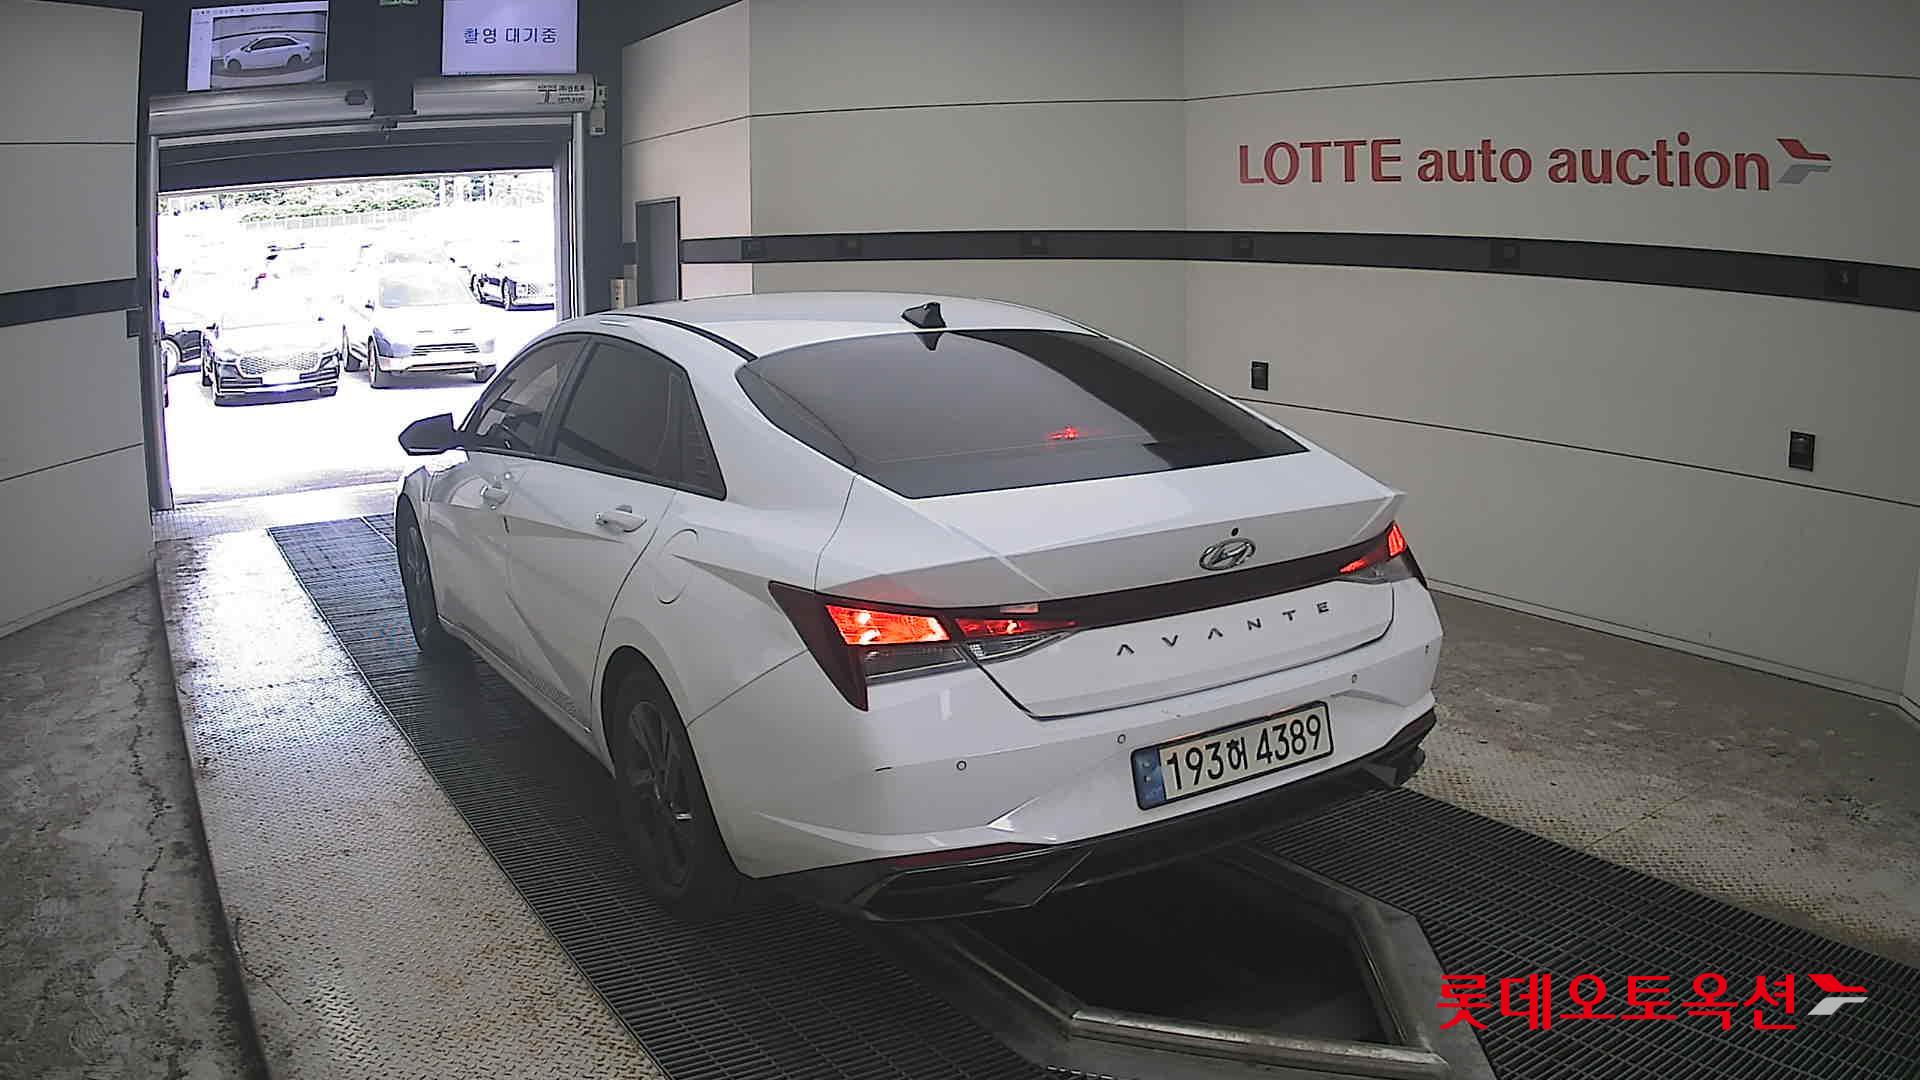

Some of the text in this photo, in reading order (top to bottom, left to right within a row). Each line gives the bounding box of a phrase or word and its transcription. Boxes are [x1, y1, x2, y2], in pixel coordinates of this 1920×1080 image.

[463, 27, 558, 44] 촬영 대기중
[1239, 131, 1770, 191] LOTTE auto auction
[1116, 601, 1330, 656] AVANTE
[1166, 714, 1322, 790] 193허 4389
